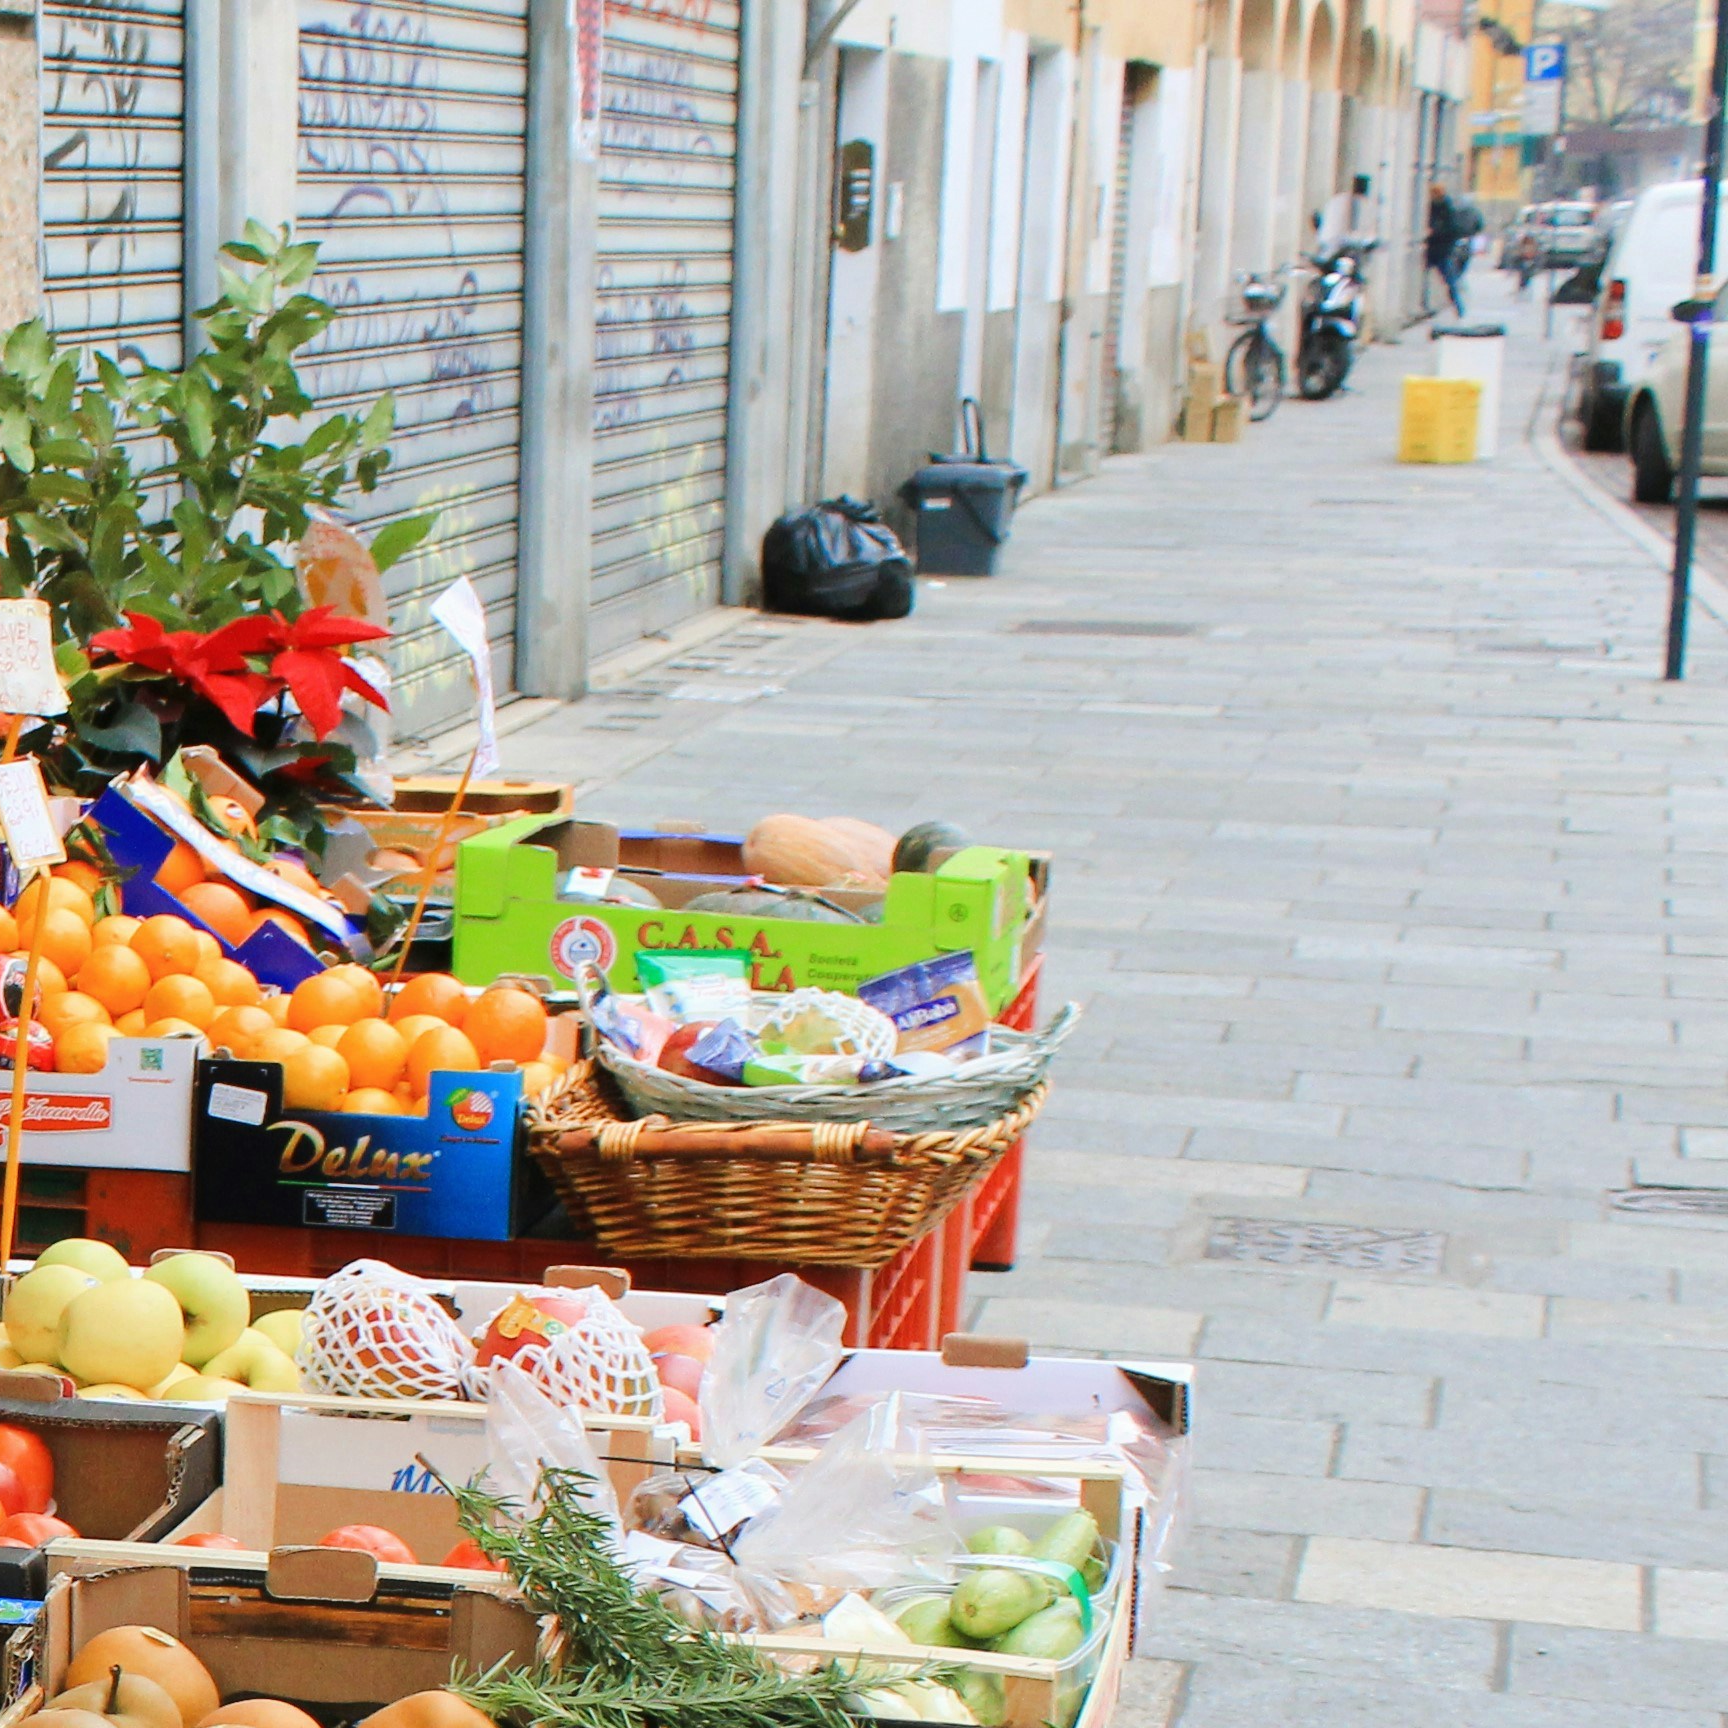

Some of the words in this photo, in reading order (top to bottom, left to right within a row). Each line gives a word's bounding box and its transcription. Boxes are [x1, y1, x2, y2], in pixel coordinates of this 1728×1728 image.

[1527, 47, 1559, 78] P
[636, 921, 783, 958] C.A.S.A.
[265, 1120, 434, 1181] Delux
